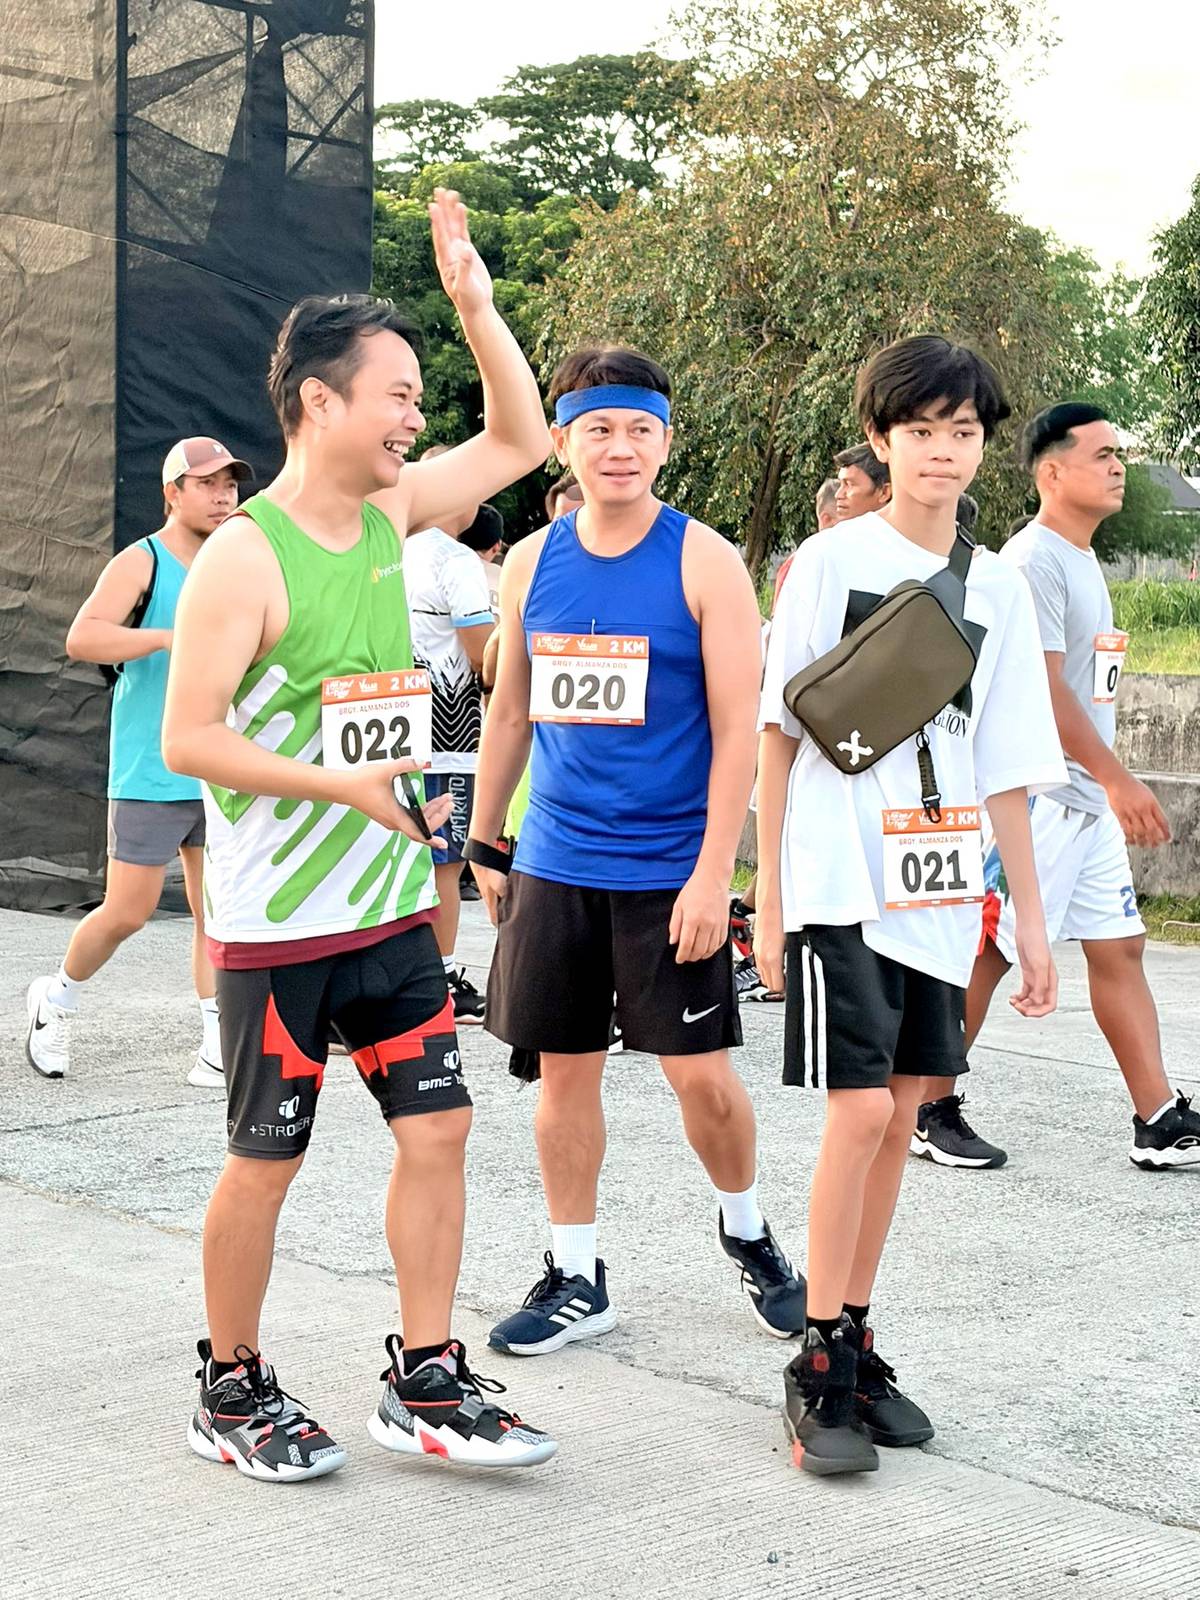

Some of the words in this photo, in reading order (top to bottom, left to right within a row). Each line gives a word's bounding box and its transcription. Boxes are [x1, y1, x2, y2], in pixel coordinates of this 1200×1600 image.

[609, 640, 619, 654] 2
[623, 641, 645, 654] KM
[390, 677, 400, 691] 2
[405, 674, 428, 690] KM
[552, 673, 626, 711] 020
[1107, 665, 1118, 693] 0
[360, 702, 393, 713] ALMANZA
[394, 701, 410, 709] DOS
[341, 716, 411, 764] 022
[946, 811, 955, 825] 2
[958, 811, 978, 825] KM
[901, 849, 968, 893] 021
[1120, 885, 1137, 918] 2
